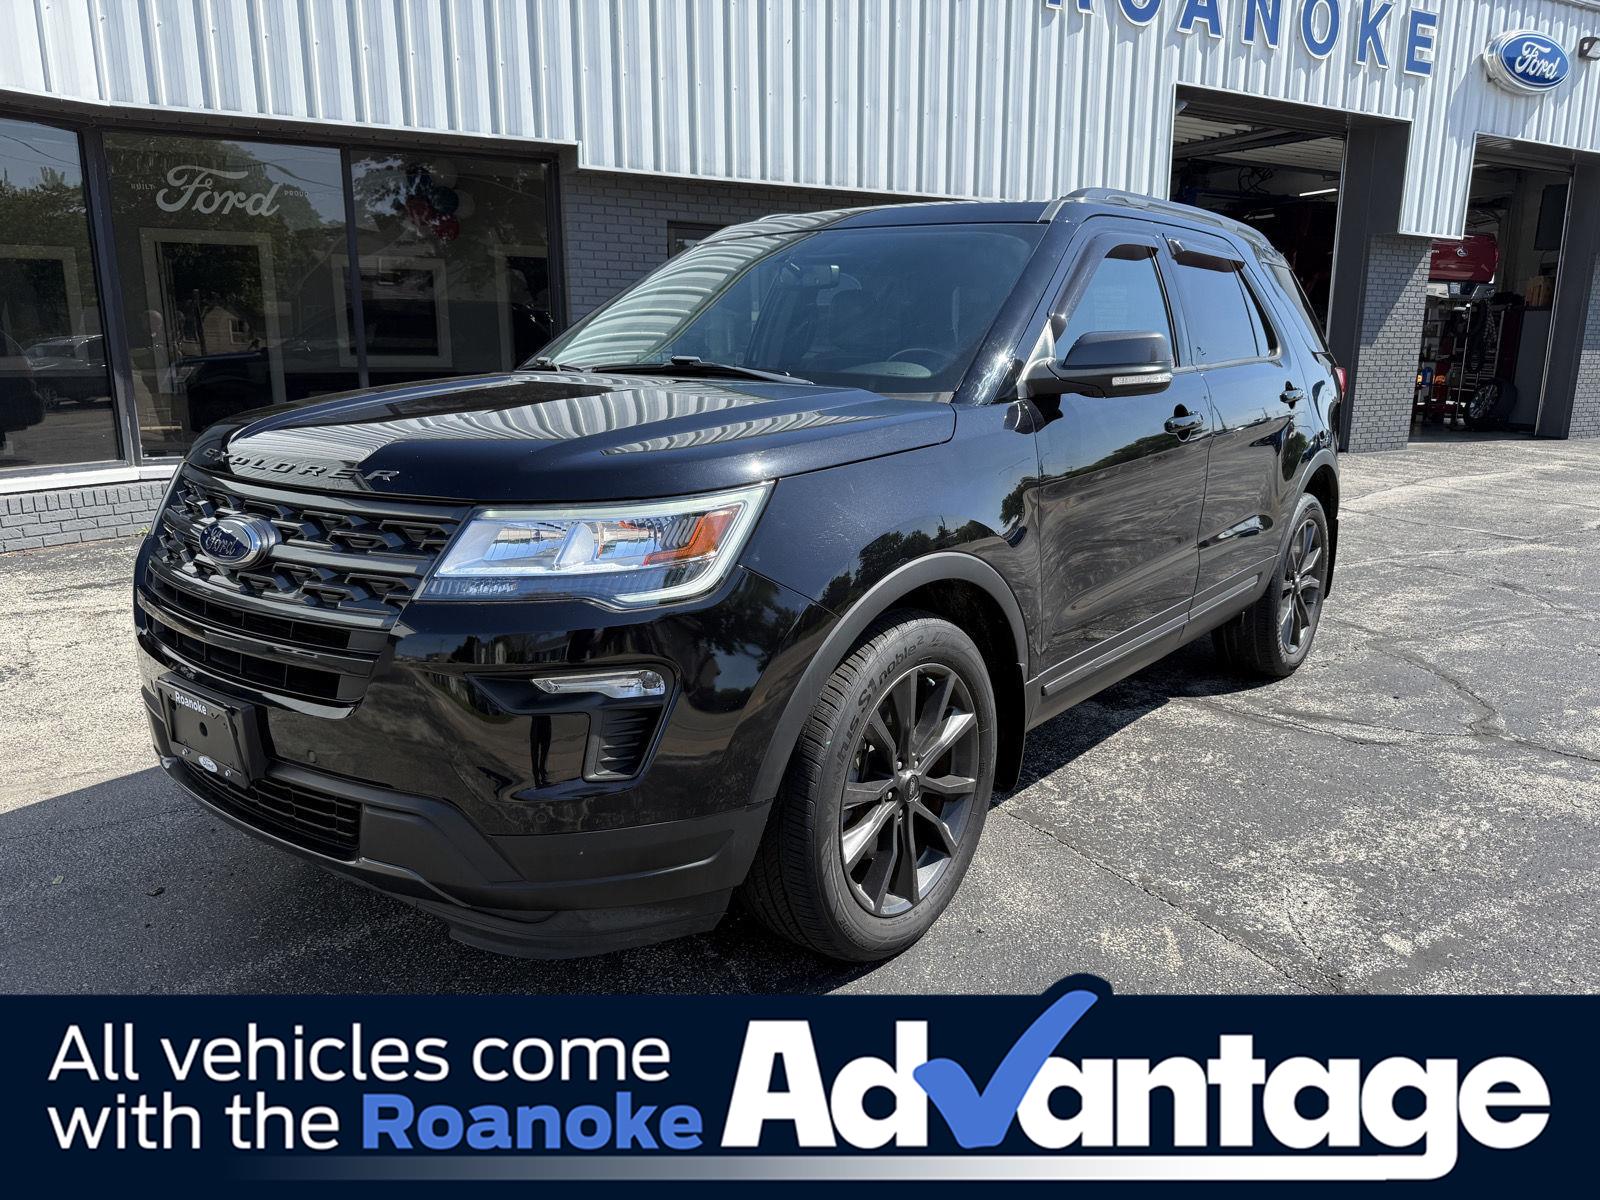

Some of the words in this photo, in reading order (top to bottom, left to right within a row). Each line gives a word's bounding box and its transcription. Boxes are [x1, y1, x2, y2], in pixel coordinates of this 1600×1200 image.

[1046, 0, 1438, 78] ANOKE
[1514, 41, 1560, 81] Ford
[156, 165, 281, 217] Ford
[284, 190, 310, 198] PROUD
[203, 448, 400, 481] EXPLORER
[175, 691, 207, 715] Roanoke
